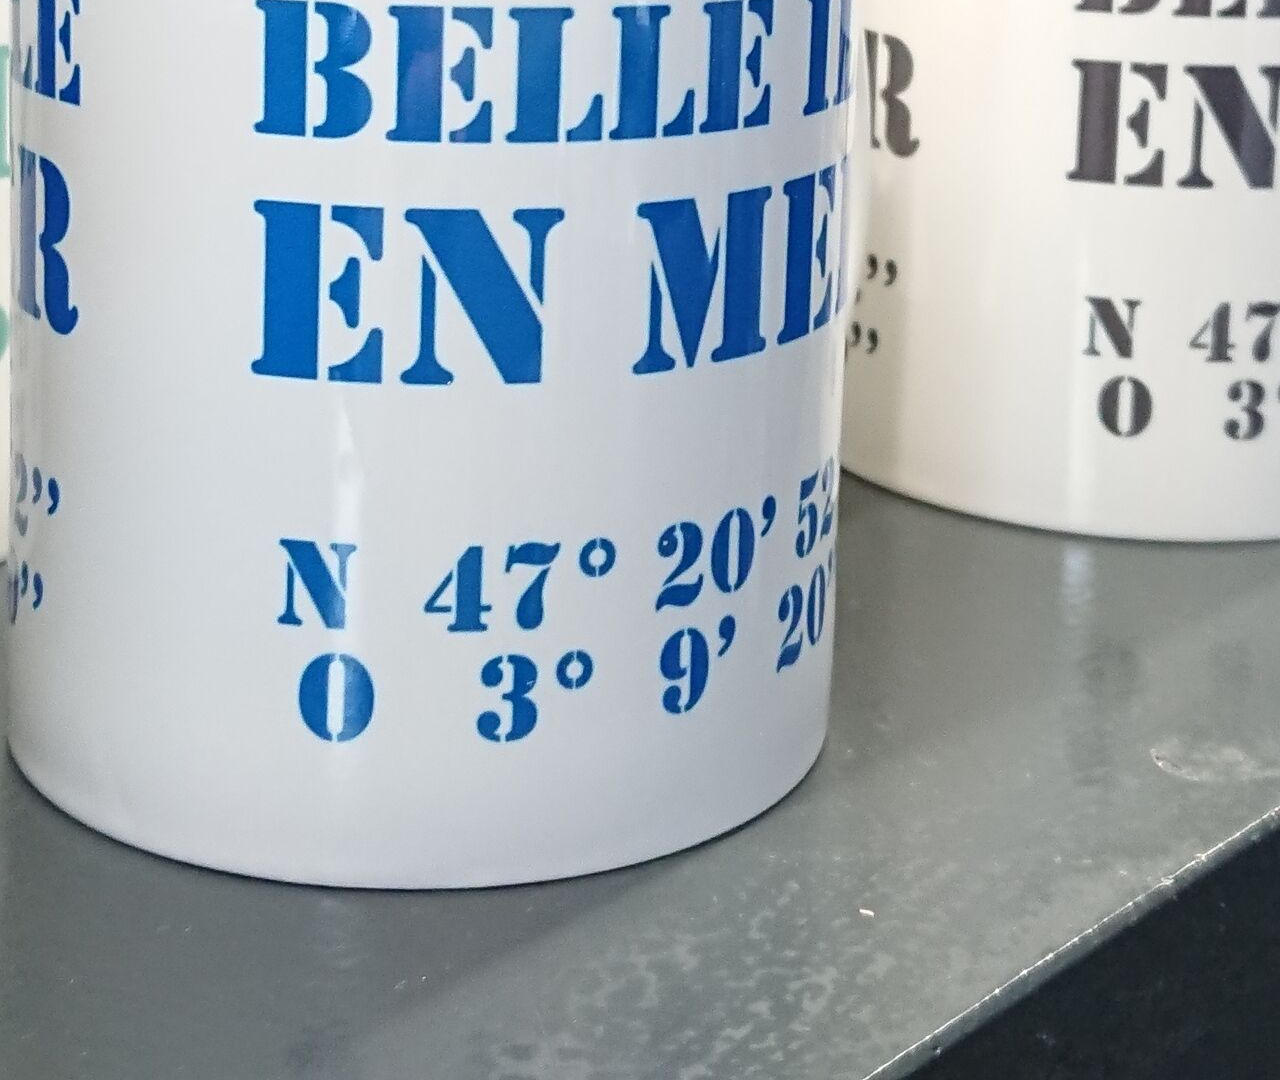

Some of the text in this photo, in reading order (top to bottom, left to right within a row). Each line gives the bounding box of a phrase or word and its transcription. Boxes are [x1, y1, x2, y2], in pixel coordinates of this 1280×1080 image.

[251, 199, 566, 386] EN
[632, 155, 848, 376] ME
[1082, 296, 1142, 359] N
[1098, 376, 1152, 438] O
[277, 538, 357, 630] N
[298, 653, 375, 742] O
